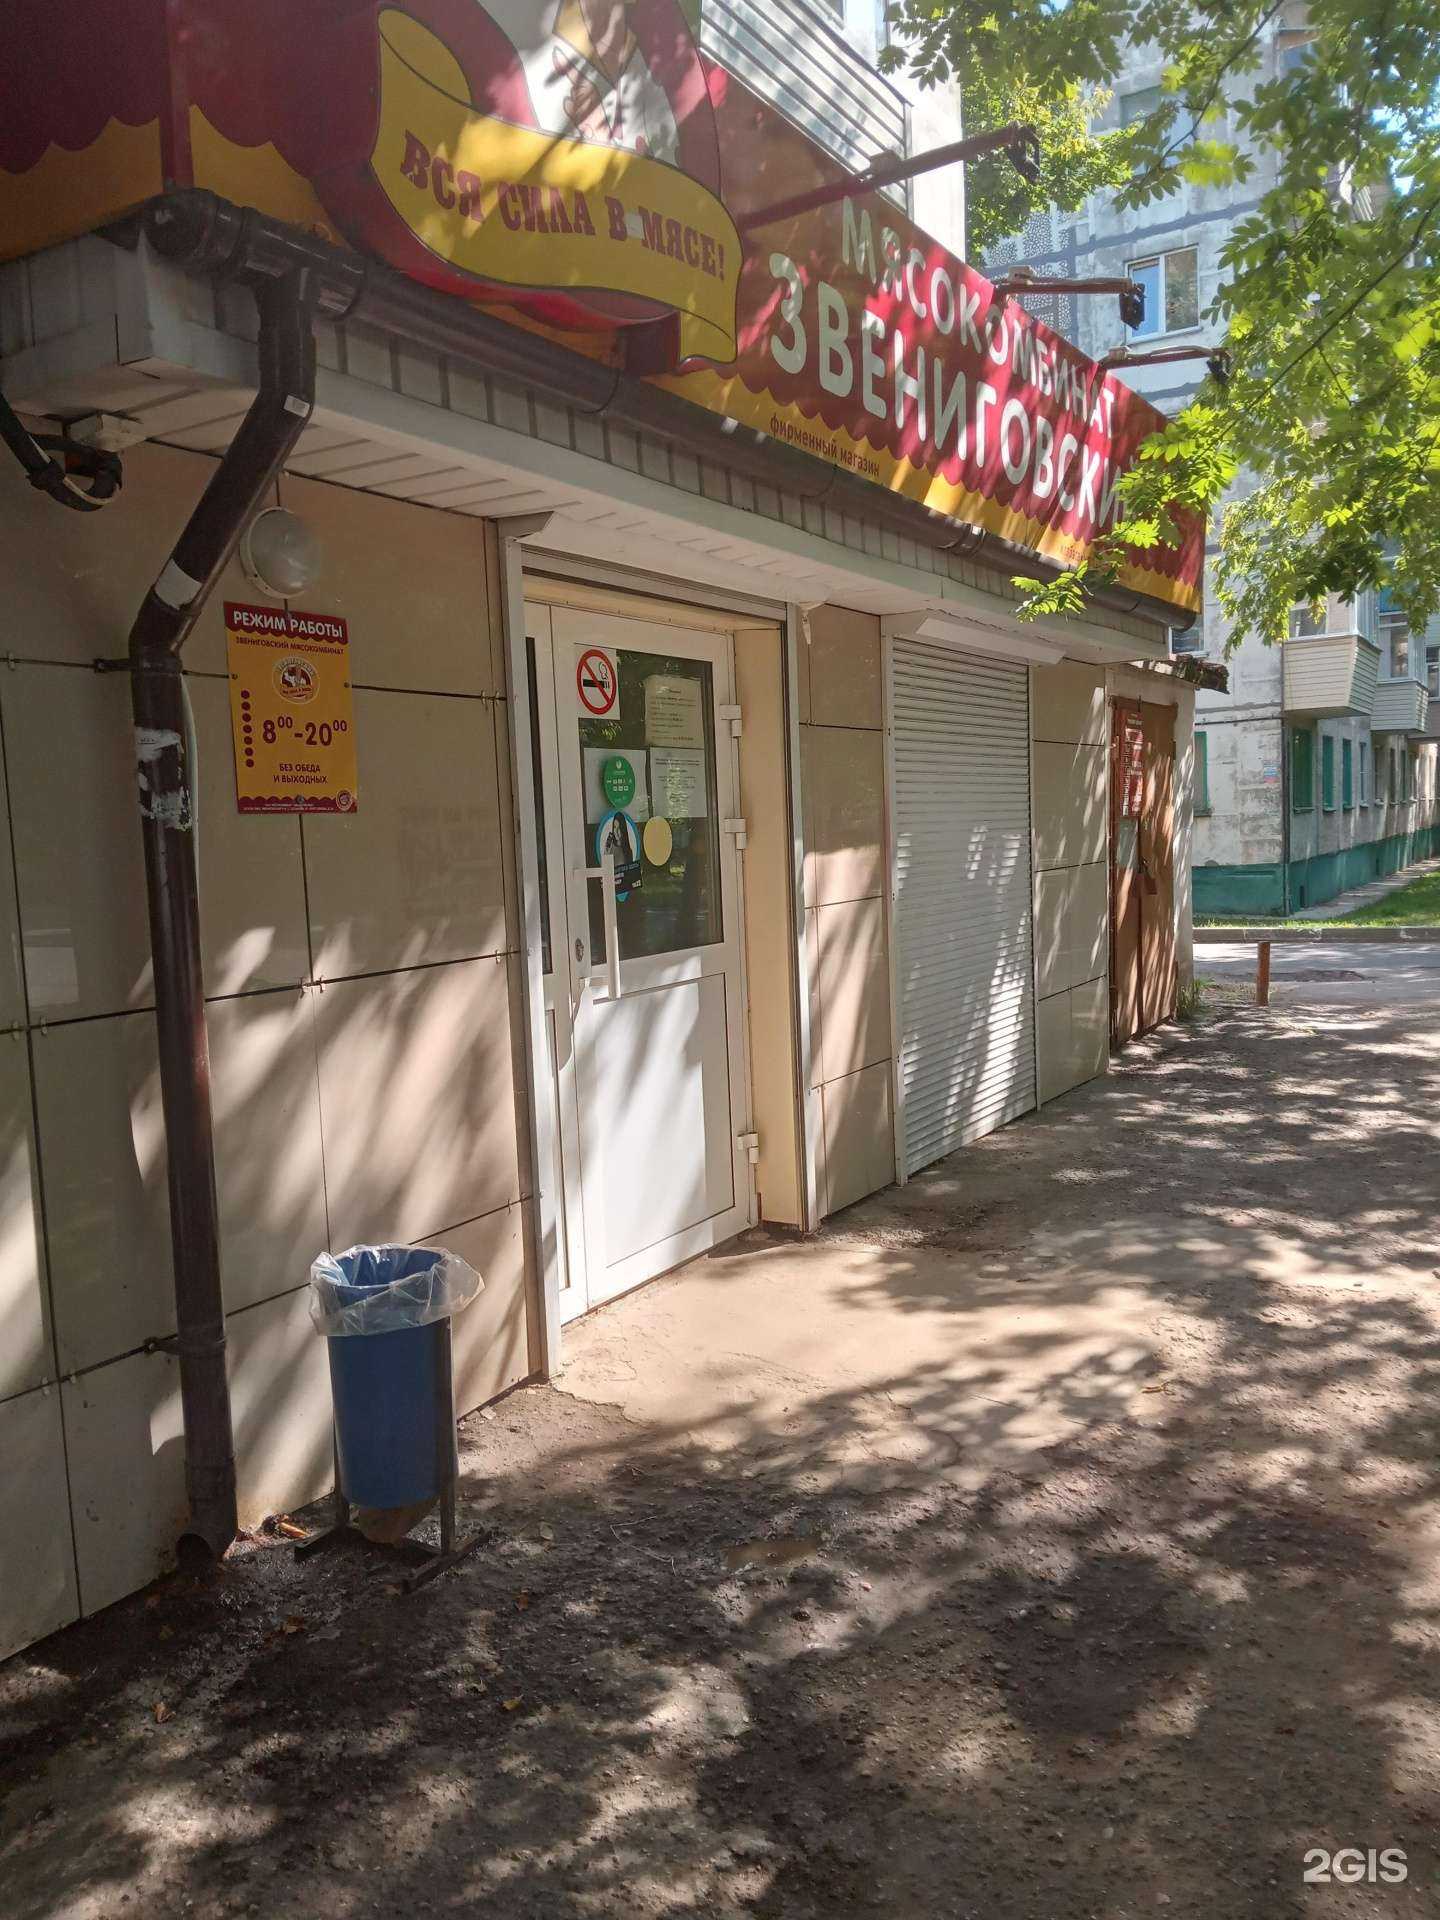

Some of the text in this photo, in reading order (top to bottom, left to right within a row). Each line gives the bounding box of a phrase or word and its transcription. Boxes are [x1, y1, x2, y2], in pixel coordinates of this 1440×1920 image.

[400, 129, 725, 280] ВСЯ СИЛА В МЯСЕ!
[841, 195, 1115, 439] МЯСОКОМБИНАТ
[768, 251, 1137, 530] ЗВЕНИГОВСКИ
[770, 412, 880, 477] фирменный магазин
[233, 610, 343, 639] РЕЖИМ РАБОТЫ
[273, 775, 327, 786] И ВЫХОДНЫХ
[279, 763, 320, 774] БЕЗ ОБЕДА
